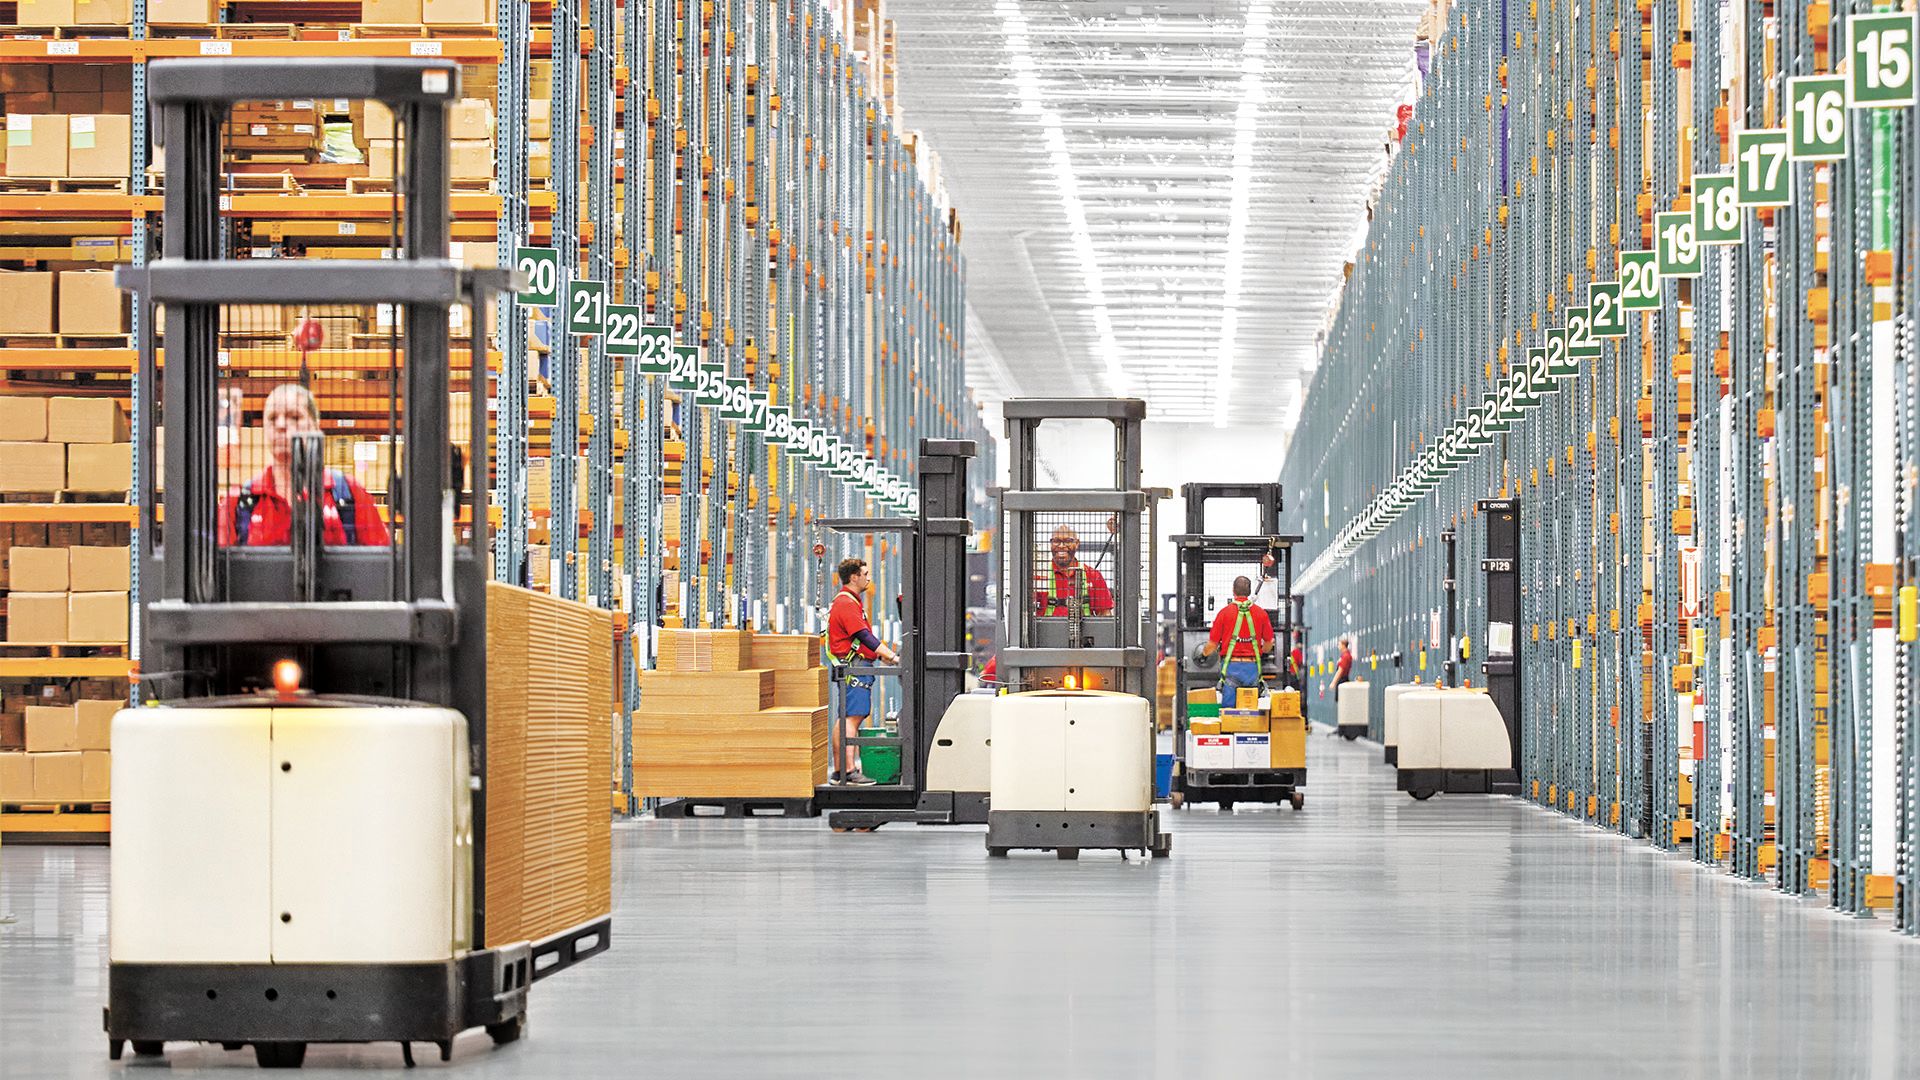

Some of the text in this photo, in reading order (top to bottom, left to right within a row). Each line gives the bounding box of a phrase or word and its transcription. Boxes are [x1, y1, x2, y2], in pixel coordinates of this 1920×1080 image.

[1857, 30, 1910, 90] 15
[1794, 91, 1844, 146] 16
[1740, 143, 1787, 192] 17
[1696, 186, 1738, 231] 18
[1661, 223, 1698, 264] 19
[518, 257, 557, 296] 20
[1622, 261, 1659, 299] 20
[573, 290, 602, 325] 21
[1593, 292, 1625, 326] 21
[606, 313, 638, 346] 22
[640, 334, 671, 365] 23
[671, 353, 698, 383] 24
[697, 370, 724, 399] 25
[722, 386, 747, 412] 26
[763, 412, 789, 438] 28
[785, 425, 809, 450] 29
[1490, 561, 1510, 571] P129
